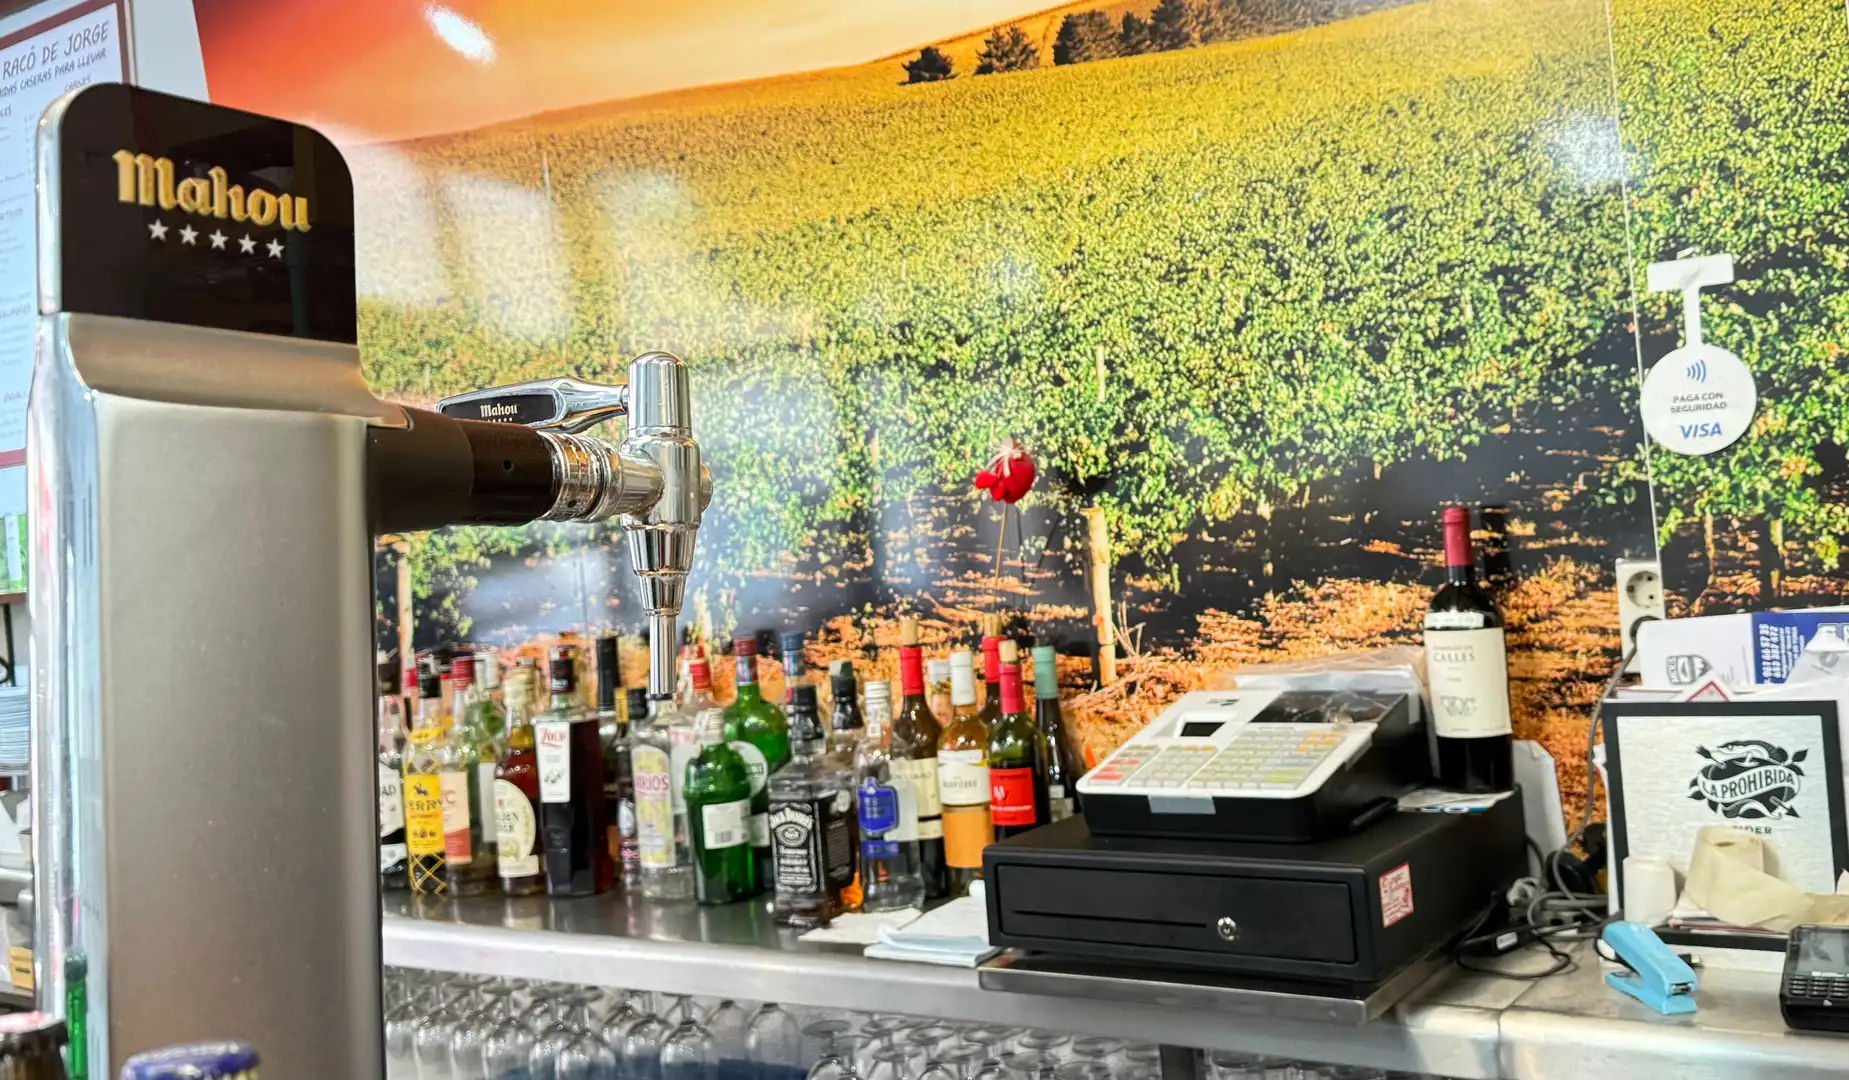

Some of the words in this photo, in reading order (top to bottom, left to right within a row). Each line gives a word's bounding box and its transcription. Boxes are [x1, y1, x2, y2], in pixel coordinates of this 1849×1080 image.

[3, 44, 36, 80] RACÓ
[42, 40, 58, 65] DE
[64, 20, 109, 56] JORGE
[54, 59, 75, 77] PARA
[112, 149, 312, 232] Mahou
[1672, 393, 1700, 403] PAGA
[1701, 391, 1723, 400] CON
[480, 402, 518, 418] Mahou
[1670, 401, 1728, 413] SEGURIDAD
[1680, 422, 1722, 438] VISA
[1702, 781, 1718, 797] LA
[1721, 768, 1794, 799] PROHIBIDA
